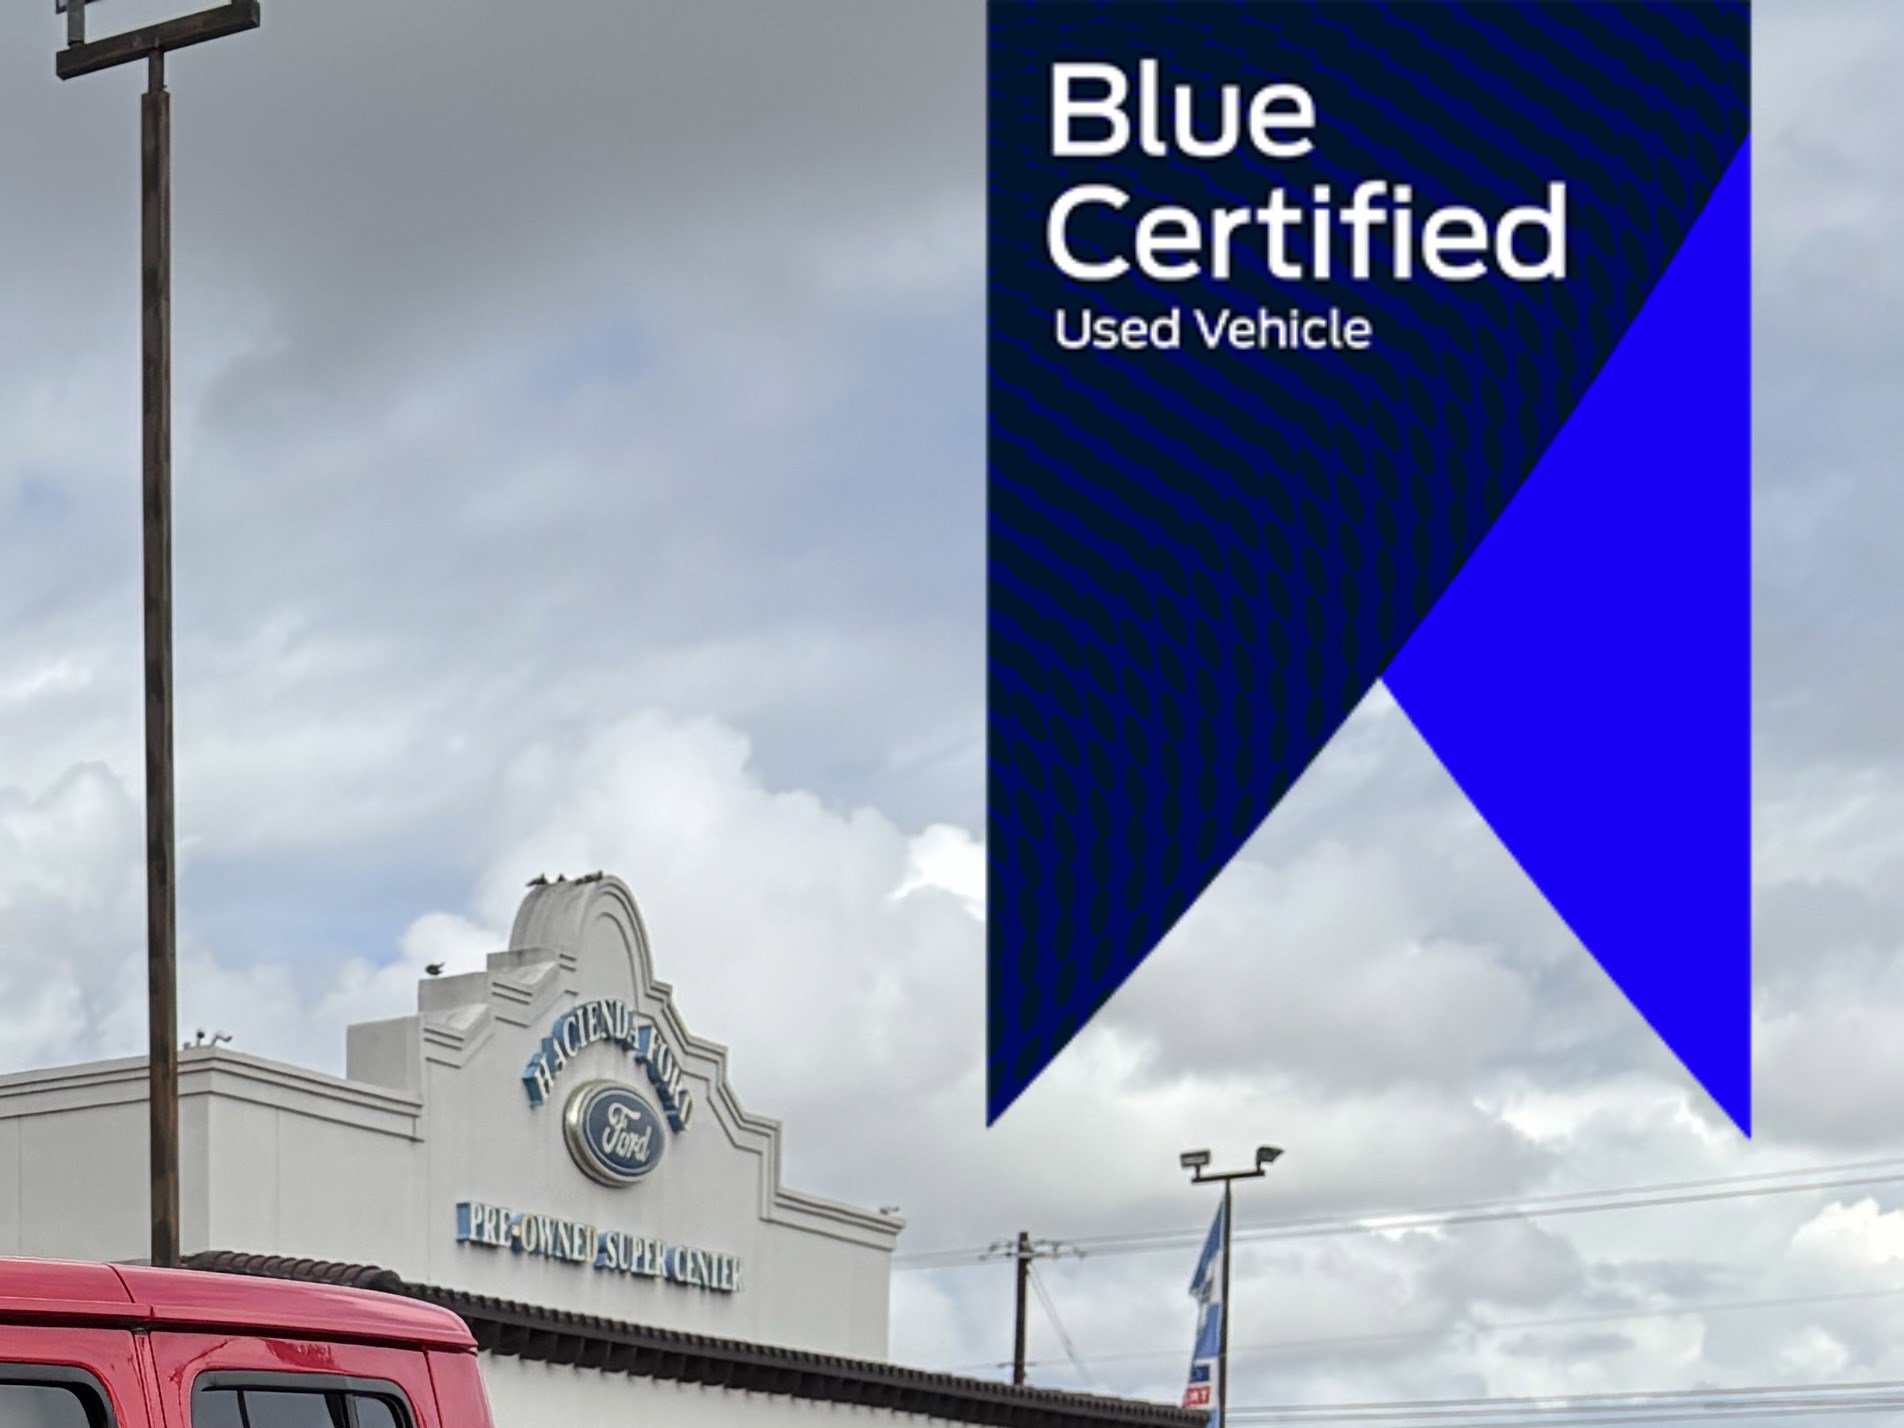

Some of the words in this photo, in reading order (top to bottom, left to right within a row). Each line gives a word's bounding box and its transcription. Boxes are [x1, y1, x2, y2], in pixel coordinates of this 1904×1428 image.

[532, 1000, 650, 1102] HACIENDA
[602, 1102, 652, 1162] Ford
[468, 1202, 599, 1264] PRE-OWNED
[605, 1230, 668, 1279] SUPER
[673, 1245, 743, 1292] CENTER
